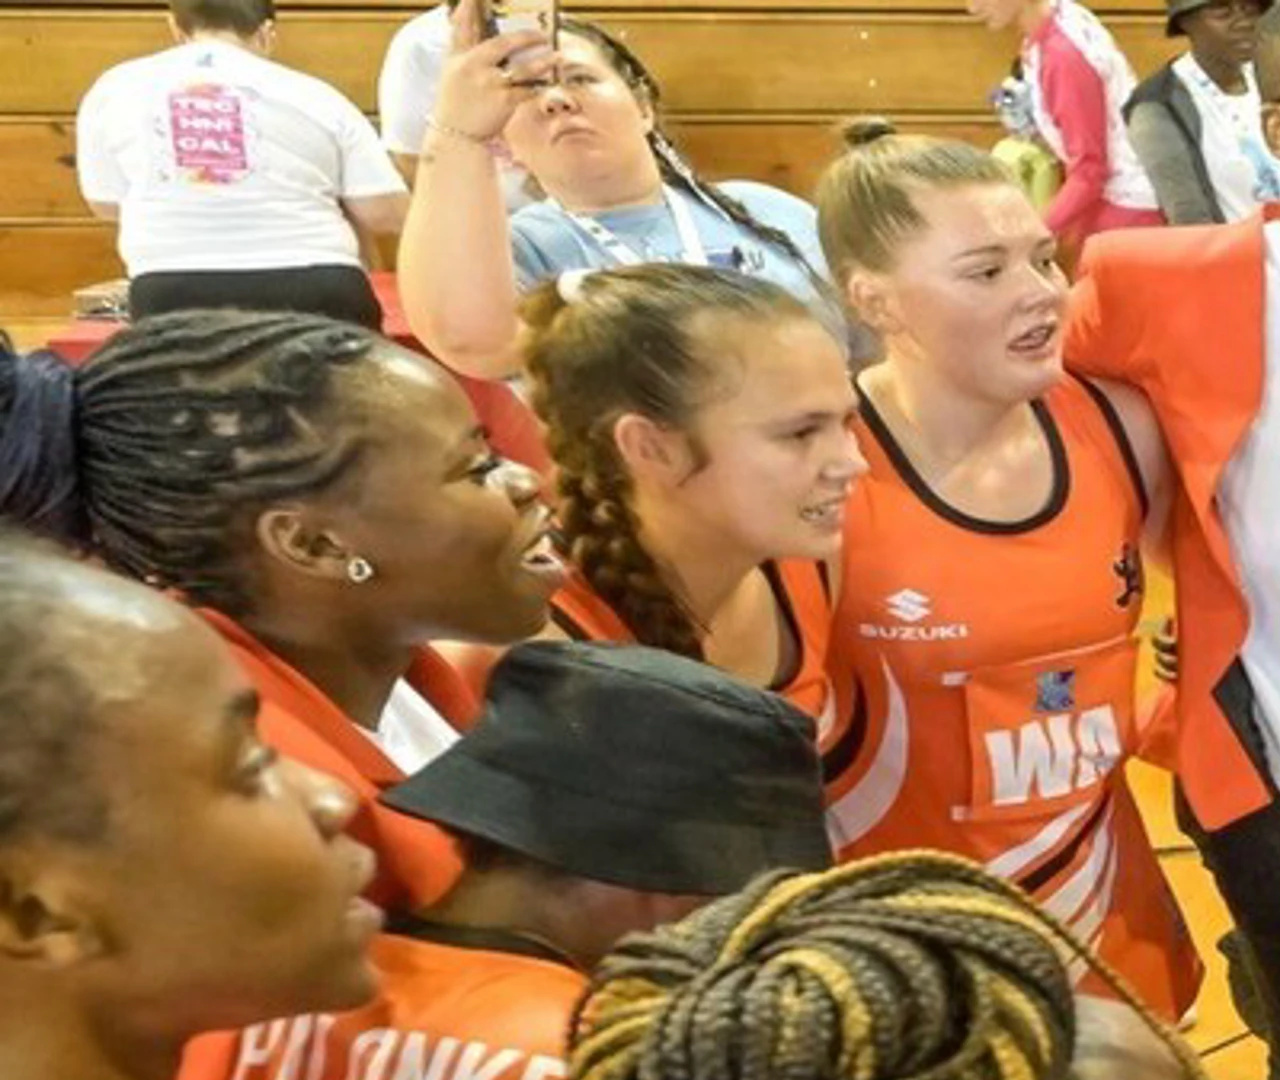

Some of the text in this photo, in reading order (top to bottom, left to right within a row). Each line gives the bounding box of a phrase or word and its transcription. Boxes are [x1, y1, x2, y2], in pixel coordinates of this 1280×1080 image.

[177, 136, 241, 155] CAL
[858, 621, 970, 642] SUZUKI
[983, 704, 1122, 807] WA
